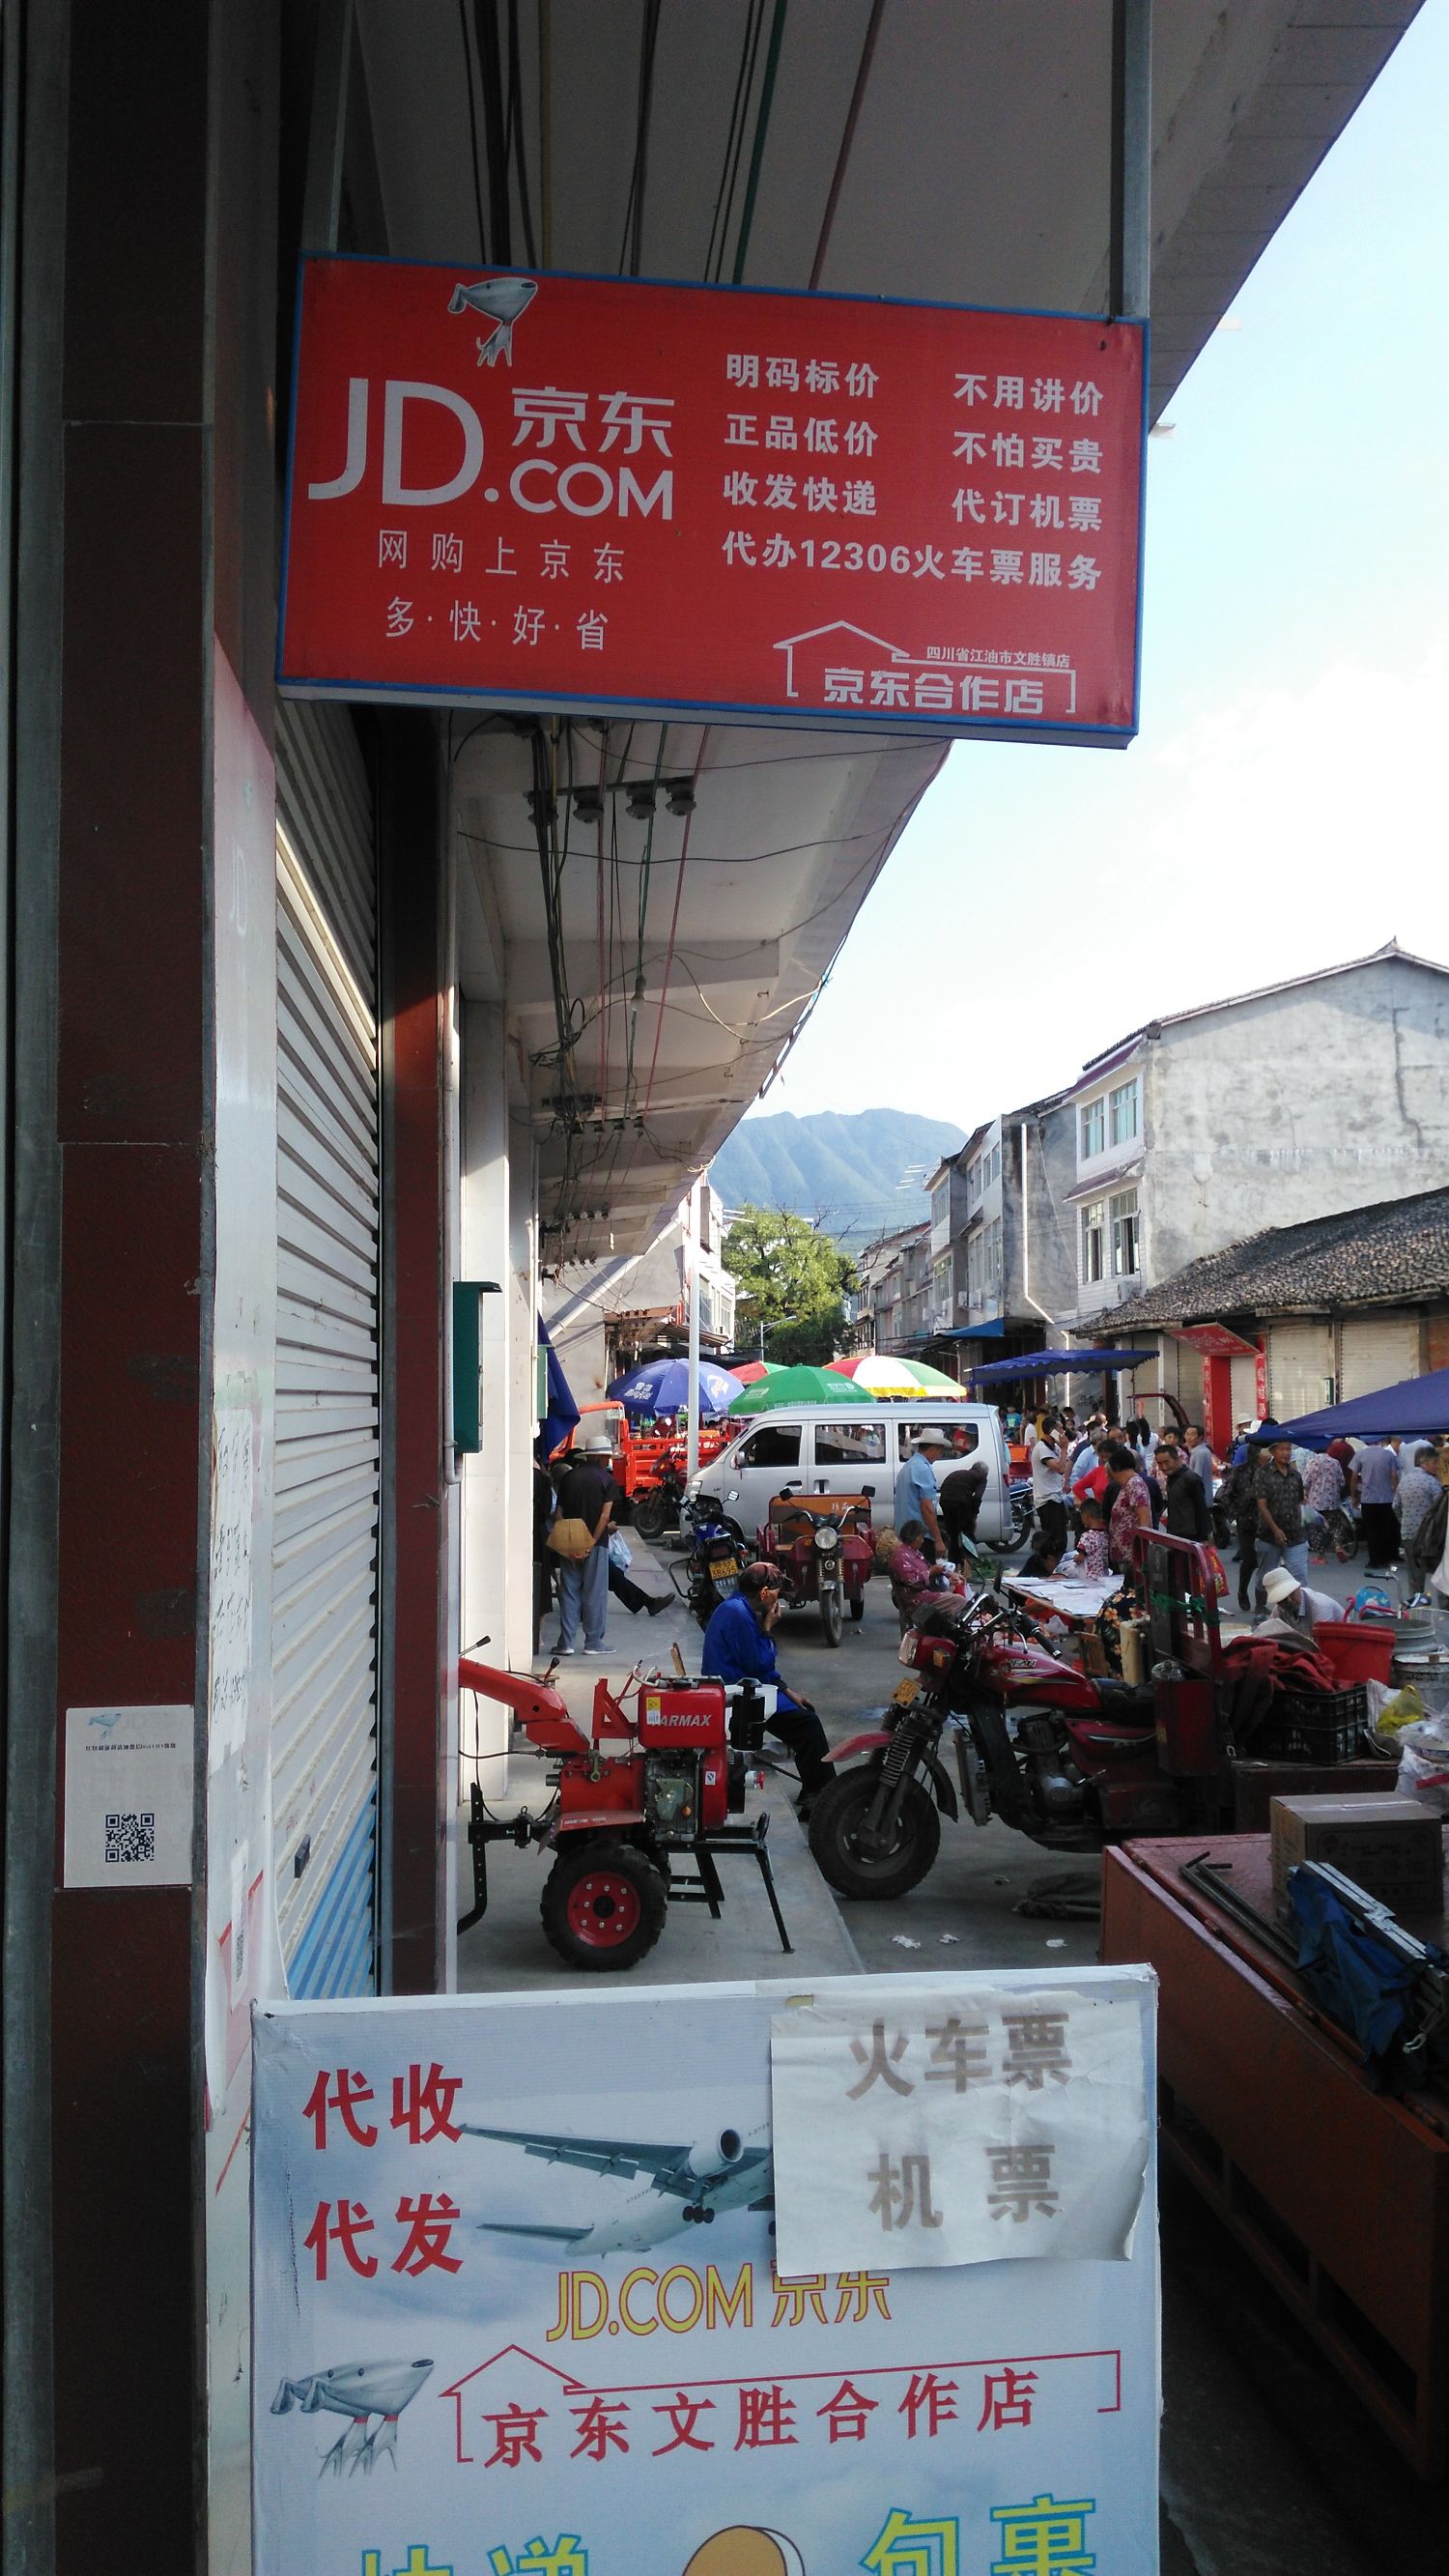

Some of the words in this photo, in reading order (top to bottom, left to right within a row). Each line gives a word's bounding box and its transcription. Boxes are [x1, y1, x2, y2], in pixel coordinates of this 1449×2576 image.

[726, 355, 879, 398] 明码标价
[953, 373, 1104, 416] 不用讲价
[512, 386, 674, 457] 京东
[724, 414, 878, 456] 正品低价
[952, 431, 1103, 474] 不怕买贵
[724, 471, 876, 516] 收发快递
[952, 488, 1102, 532] 代订机票
[379, 530, 625, 584] 网购上京东
[722, 530, 1102, 590] 代办12306火车票服务
[926, 645, 1070, 668] 四川省江油市文胜镇店
[824, 667, 1043, 714] 京东合作店
[652, 1714, 712, 1727] ARMAX
[845, 2011, 1073, 2101] 火车票
[303, 2063, 464, 2150] 代收
[867, 2143, 1060, 2232] 机票
[304, 2193, 464, 2280] 代发
[546, 2262, 753, 2342] JD.COM
[484, 2366, 1040, 2468] 京东文胜合作店
